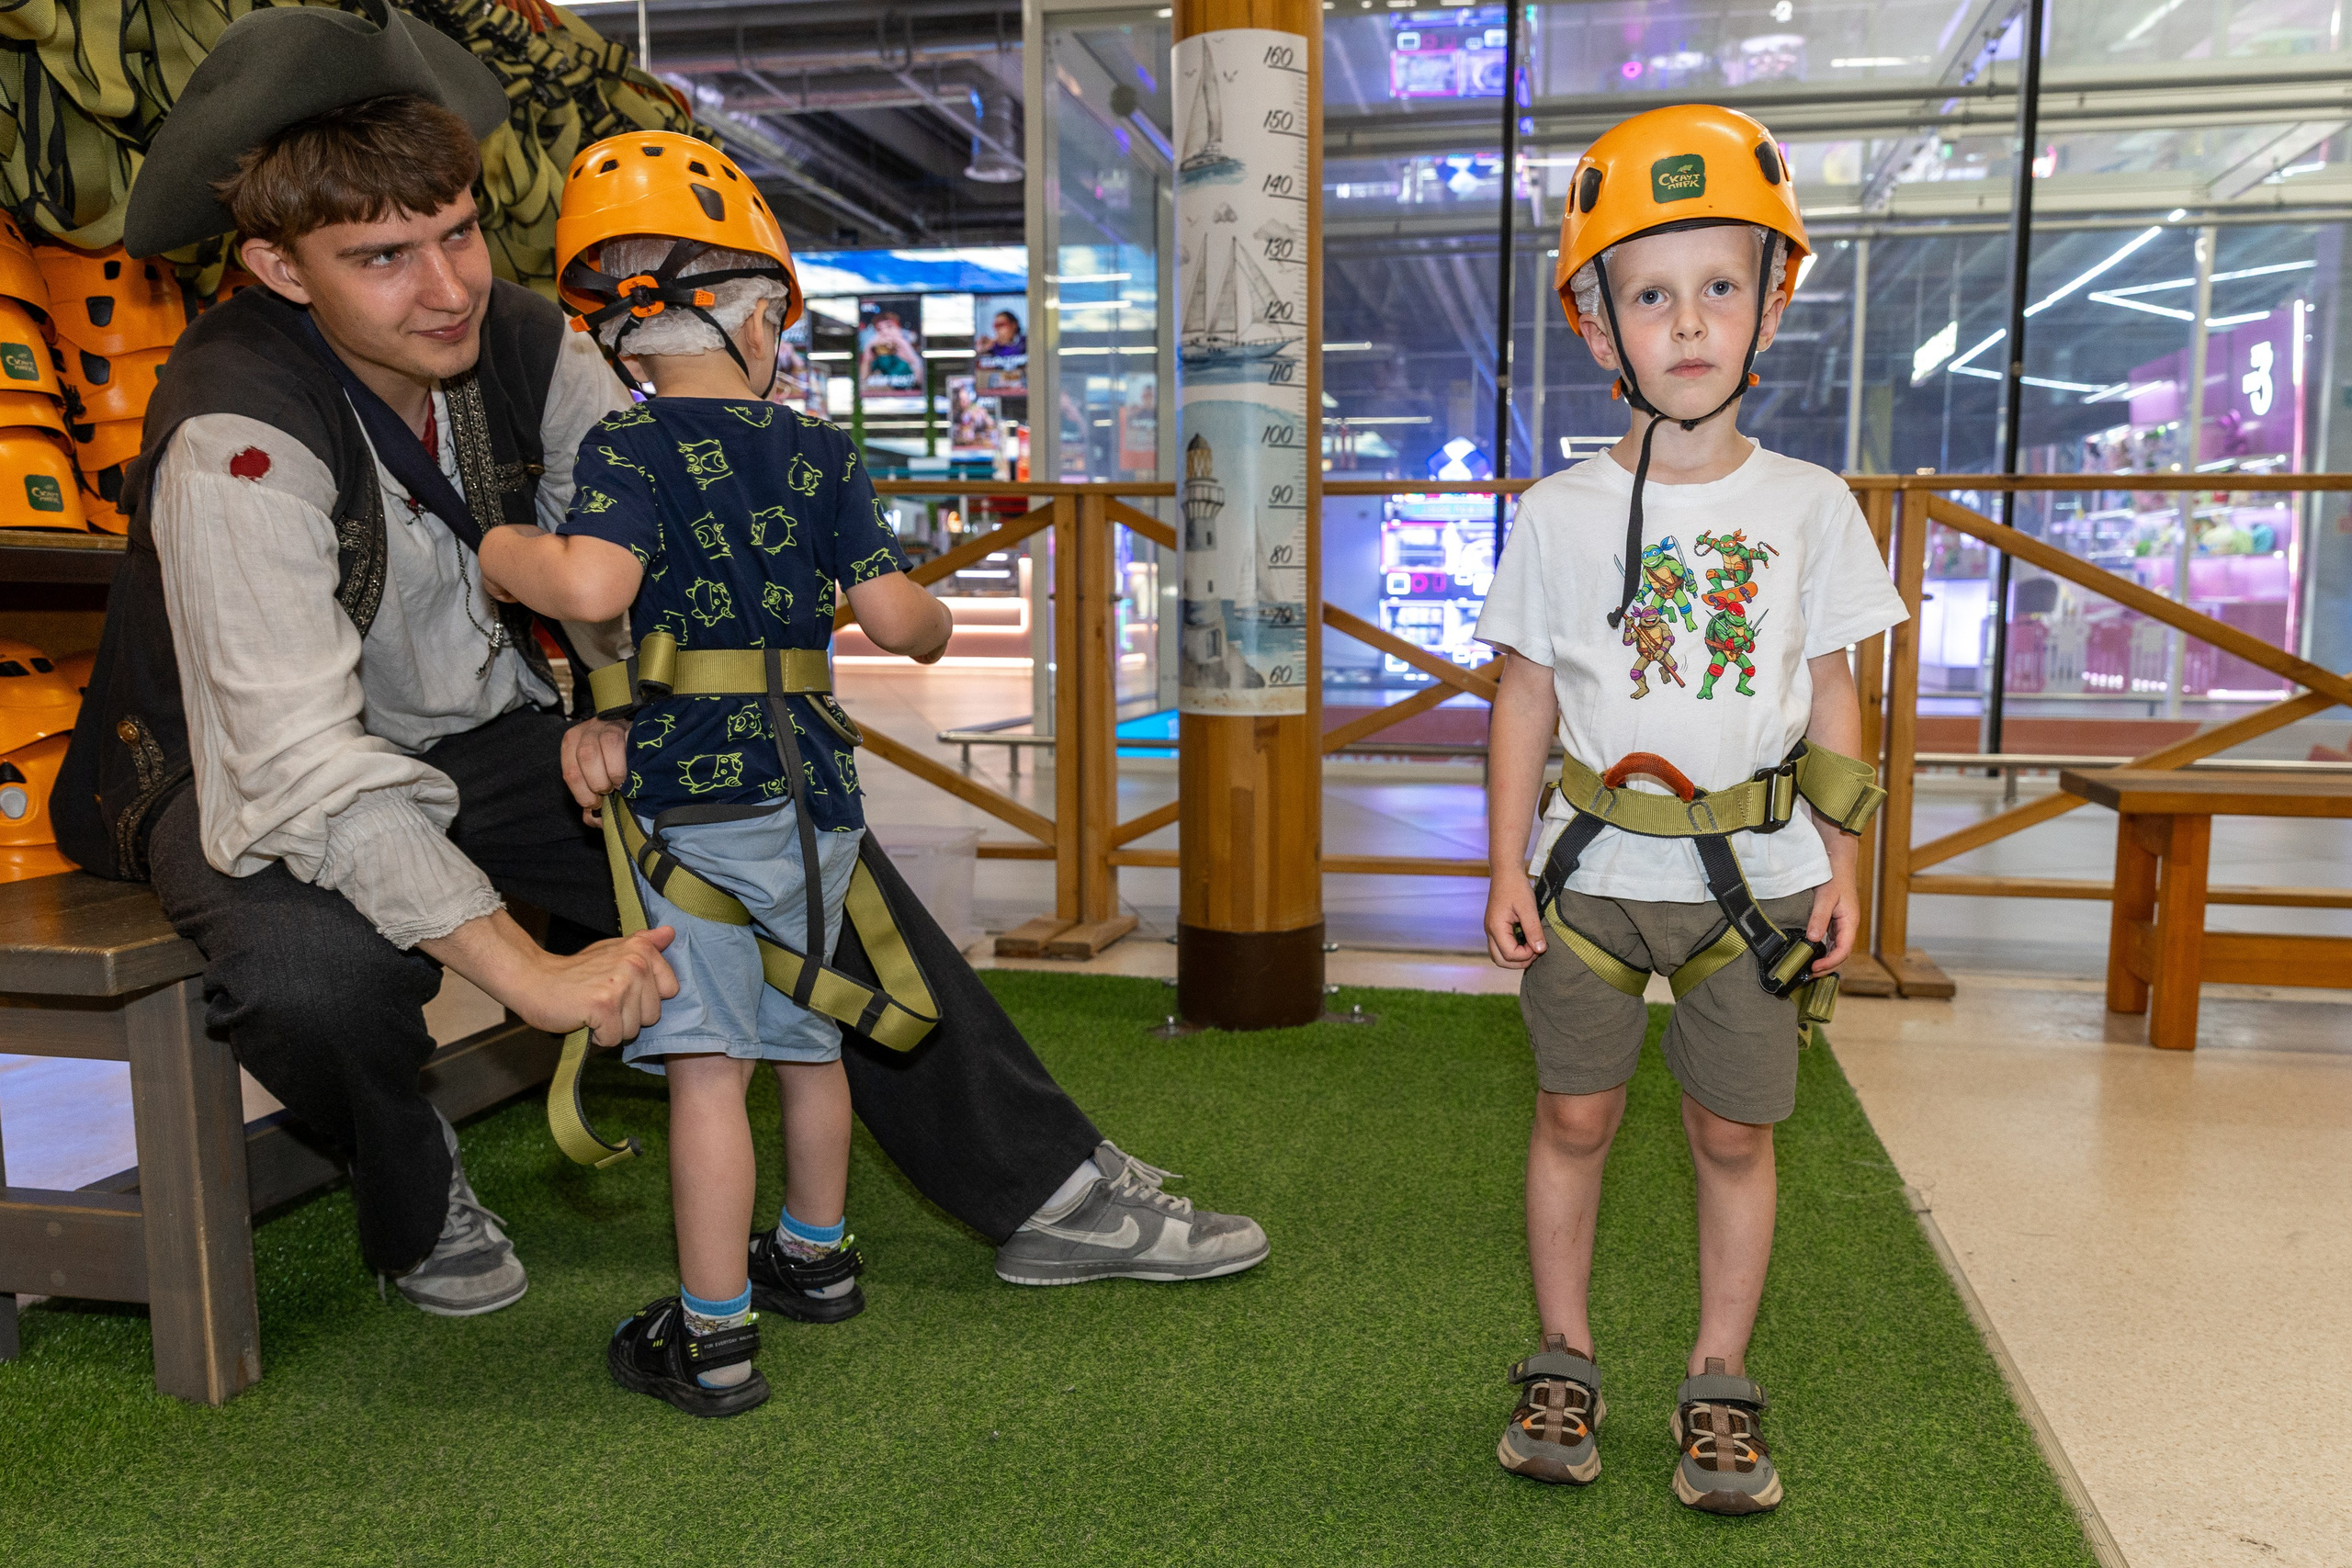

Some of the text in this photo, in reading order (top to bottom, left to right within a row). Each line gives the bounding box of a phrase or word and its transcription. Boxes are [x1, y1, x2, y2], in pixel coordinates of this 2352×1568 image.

[1263, 46, 1293, 66] 160
[1263, 110, 1293, 130] 150
[1262, 175, 1293, 194] 140
[1264, 239, 1293, 258] 130
[1264, 301, 1293, 321] 120
[1268, 363, 1292, 382] 110
[1261, 425, 1293, 444] 100
[1269, 485, 1293, 504] 90
[1270, 545, 1293, 564] 80
[1272, 606, 1293, 625] 70
[1270, 665, 1293, 683] 60
